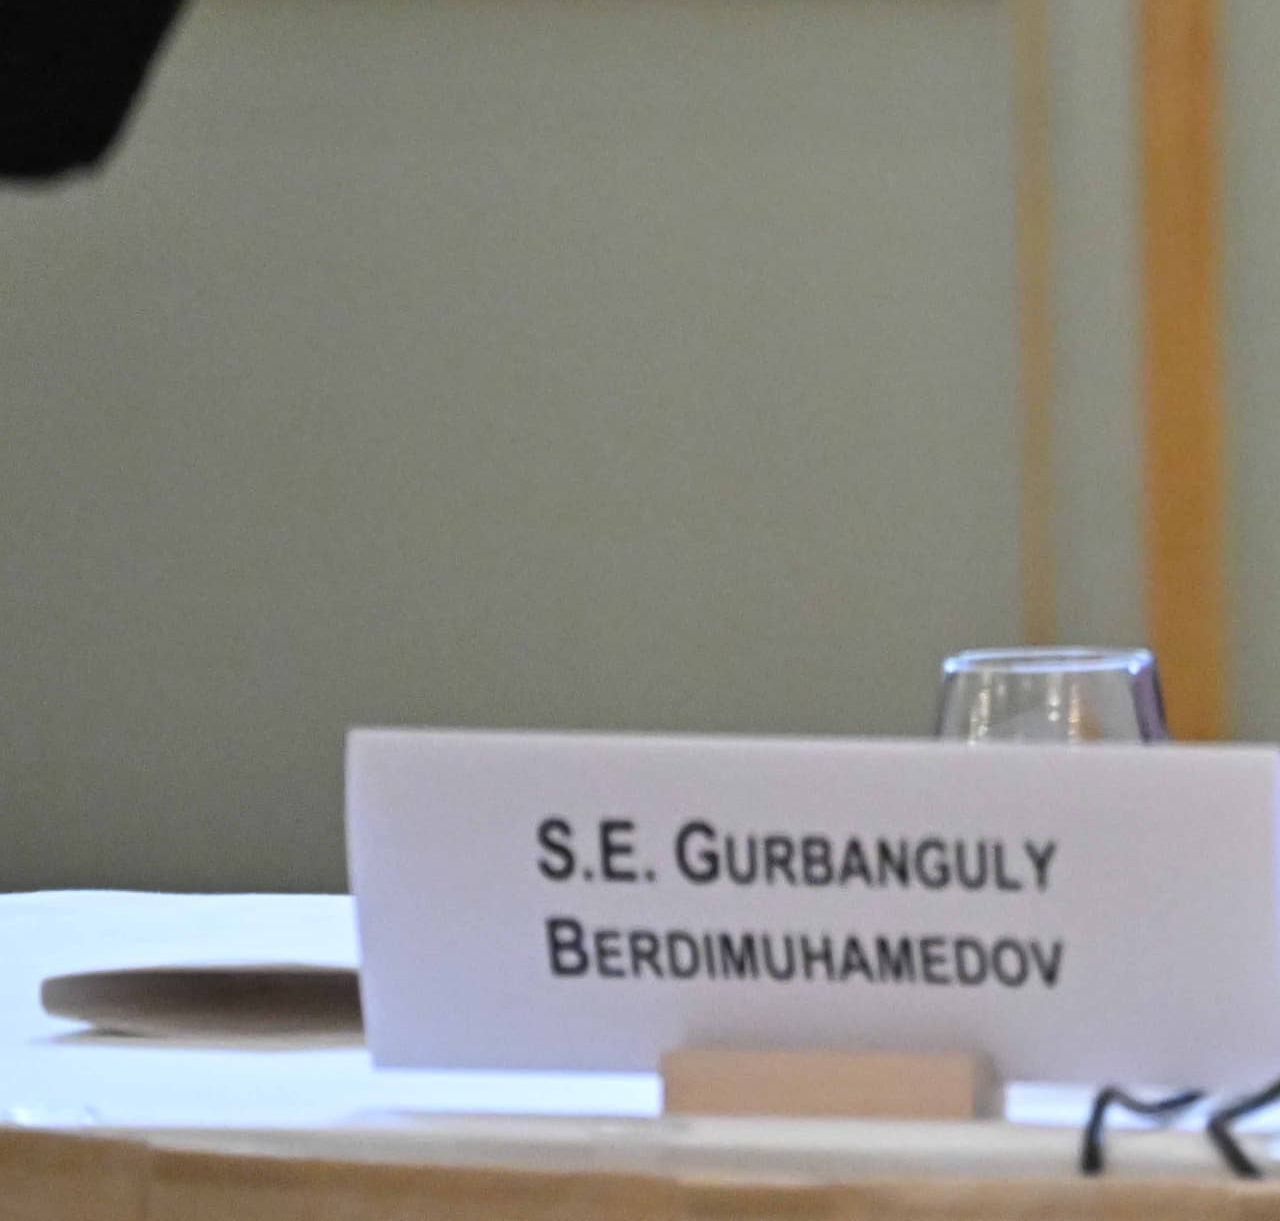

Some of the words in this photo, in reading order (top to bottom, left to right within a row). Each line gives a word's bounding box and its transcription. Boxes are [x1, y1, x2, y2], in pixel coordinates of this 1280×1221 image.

[536, 816, 656, 883] S.E.
[674, 819, 1056, 891] GURBANGULY
[545, 916, 1063, 988] BERDIMUHAMEDOV
